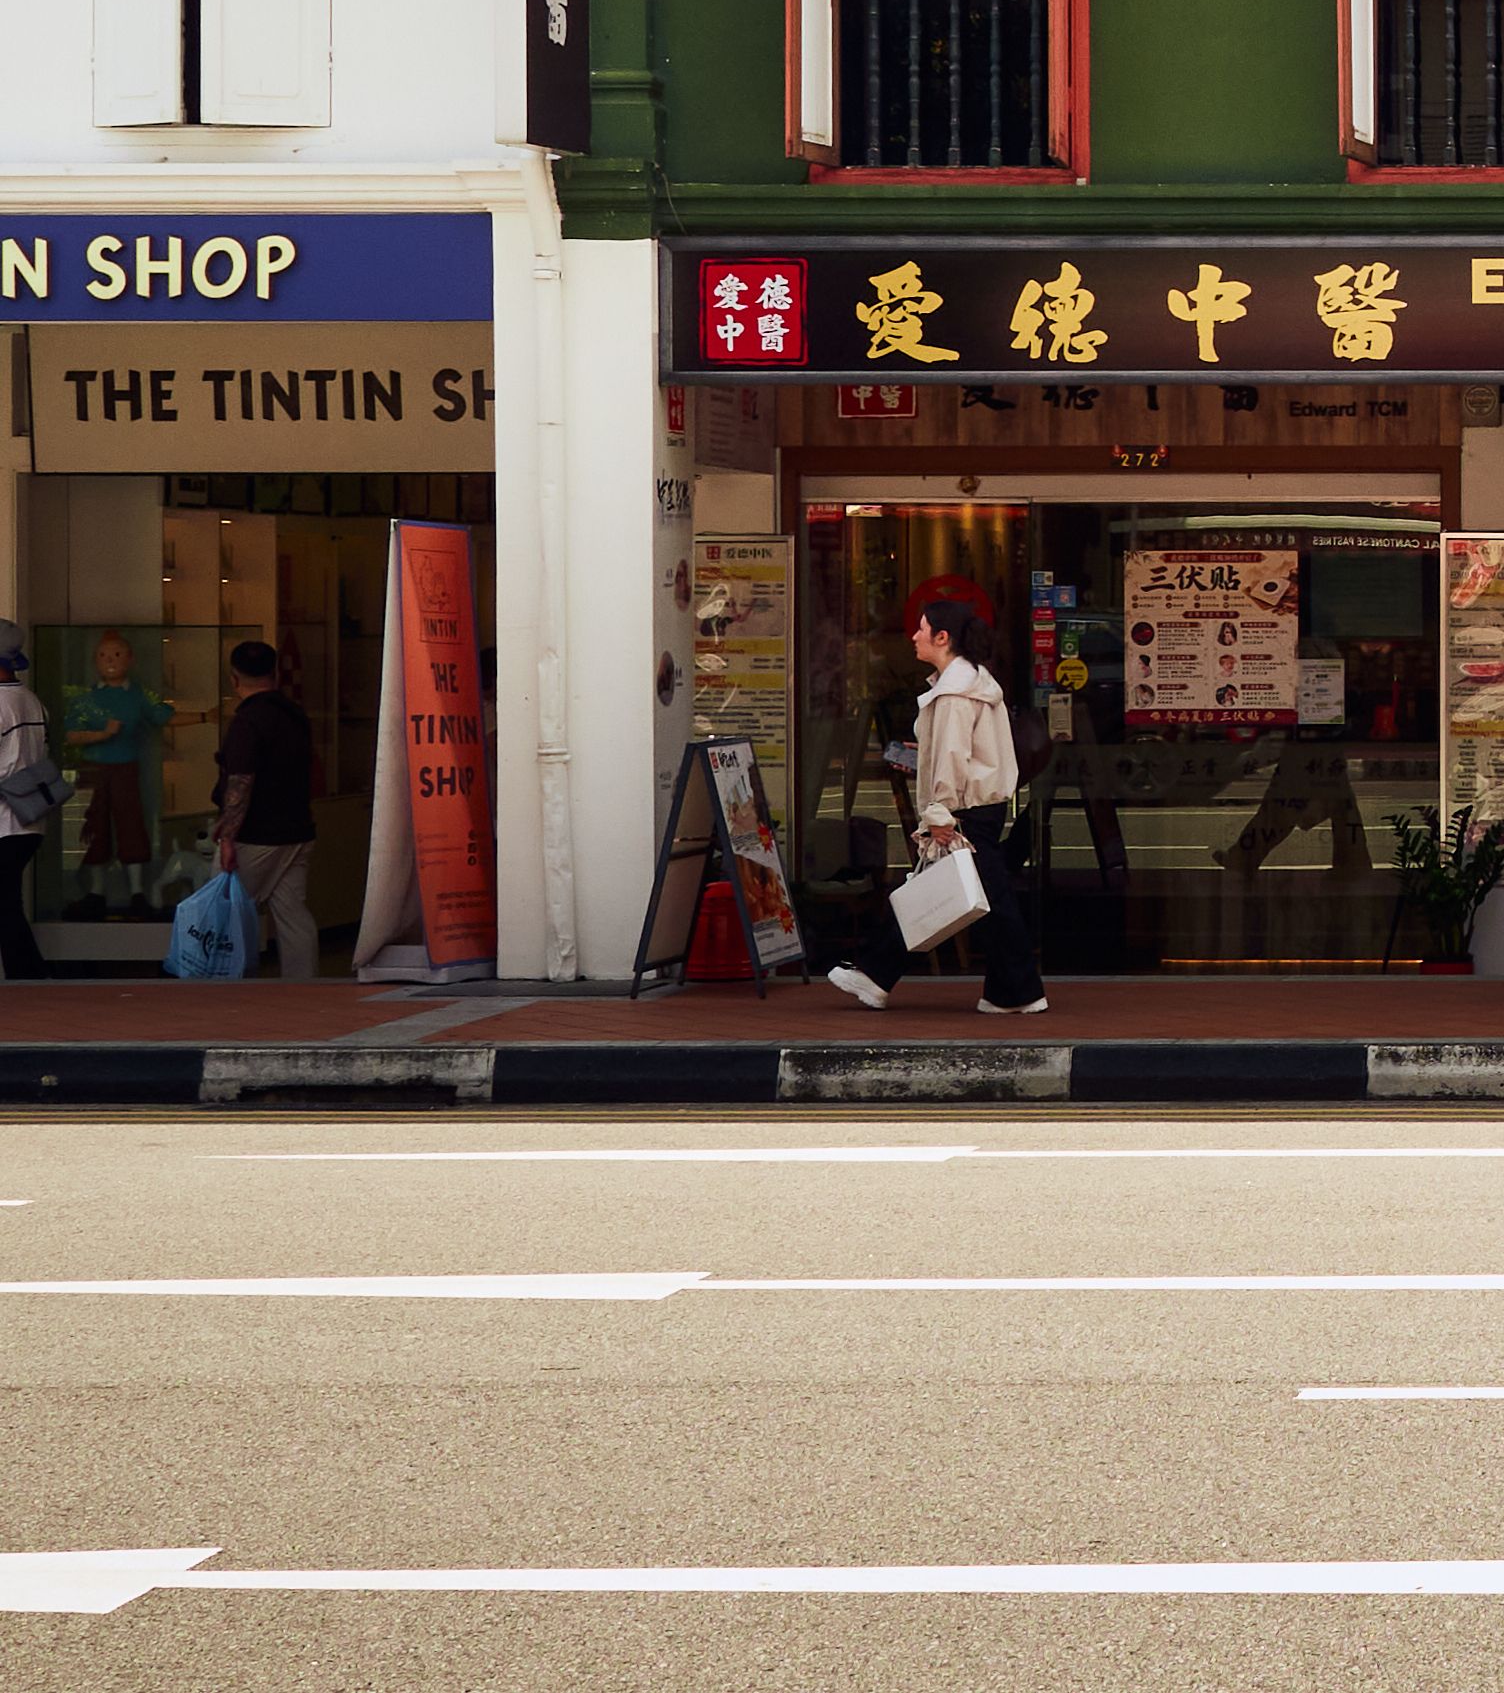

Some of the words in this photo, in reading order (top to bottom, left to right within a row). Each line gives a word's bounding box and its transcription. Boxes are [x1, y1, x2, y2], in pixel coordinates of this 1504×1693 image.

[86, 235, 297, 300] SHOP
[713, 273, 793, 310] 愛德
[855, 260, 1408, 364] 愛德中醫
[716, 313, 790, 352] 中醫
[64, 368, 179, 422] THE
[202, 368, 403, 422] TINTIN
[1289, 400, 1357, 417] Edward
[1367, 400, 1408, 417] TCM
[1121, 453, 1159, 467] 272
[1140, 564, 1242, 593] 三伏贴
[431, 663, 459, 693] THE
[411, 714, 478, 745] TINTIN
